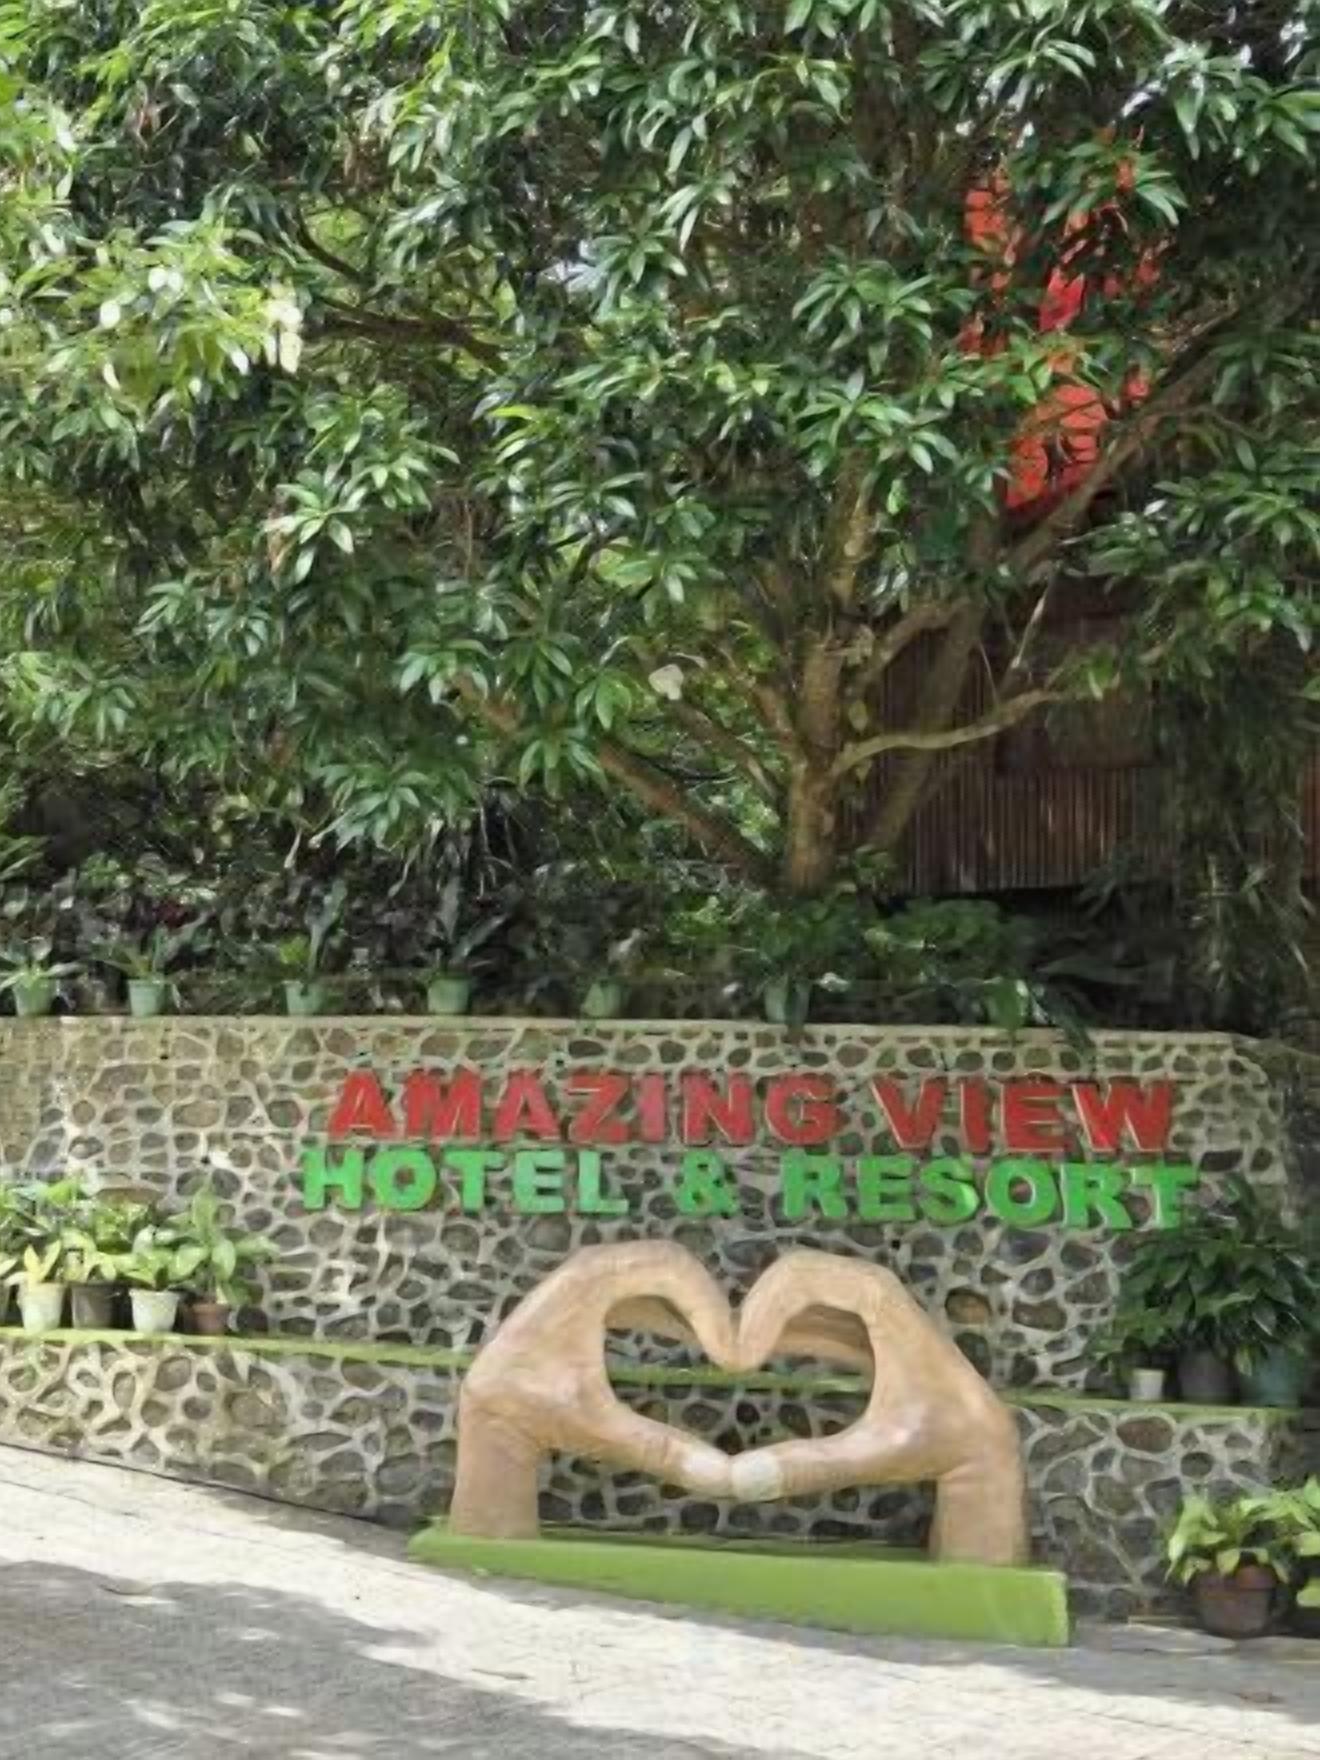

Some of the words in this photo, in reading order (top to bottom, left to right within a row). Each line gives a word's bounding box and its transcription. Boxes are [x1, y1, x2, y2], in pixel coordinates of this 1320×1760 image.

[328, 1069, 838, 1145] AMAZING
[871, 1076, 1173, 1153] VIEW
[301, 1148, 629, 1212] HOTEL
[679, 1151, 738, 1215] &
[781, 1152, 1198, 1229] RESORT
